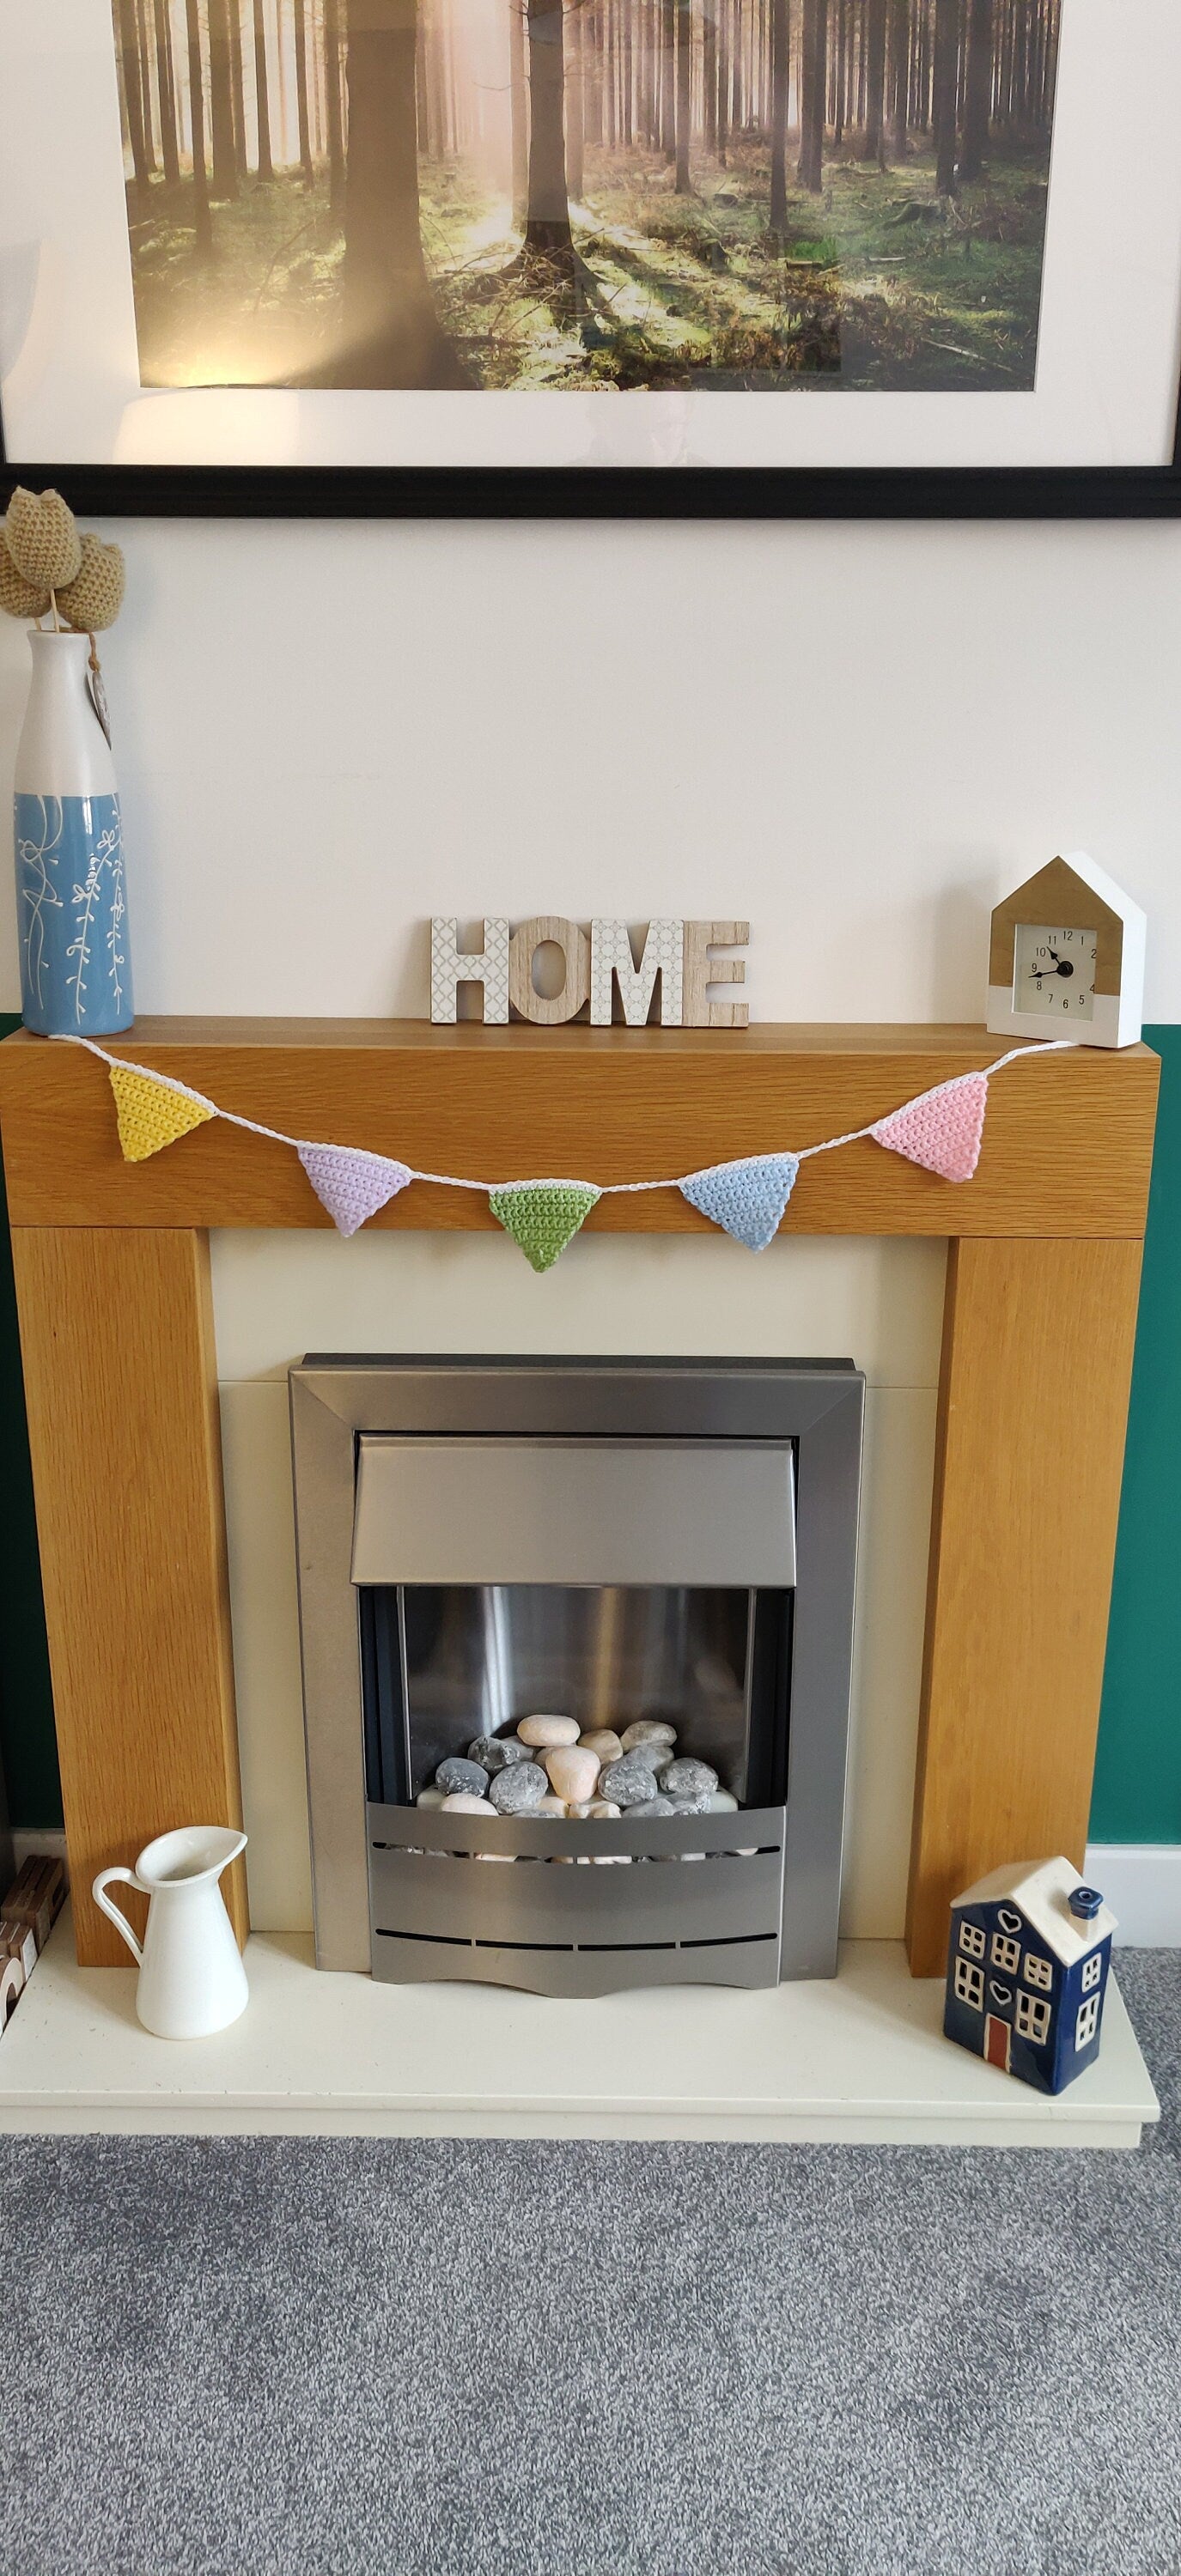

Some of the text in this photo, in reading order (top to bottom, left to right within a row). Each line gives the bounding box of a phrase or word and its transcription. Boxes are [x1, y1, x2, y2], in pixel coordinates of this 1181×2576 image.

[1063, 931, 1073, 940] 12
[1048, 936, 1056, 945] 11
[1036, 948, 1046, 957] 10
[1091, 949, 1097, 958] 2
[431, 916, 749, 1027] HOME
[1032, 963, 1037, 972] 9
[1037, 981, 1042, 990] 8
[1049, 994, 1053, 1003] 7
[1079, 995, 1085, 1005] 5
[1063, 999, 1068, 1009] 6
